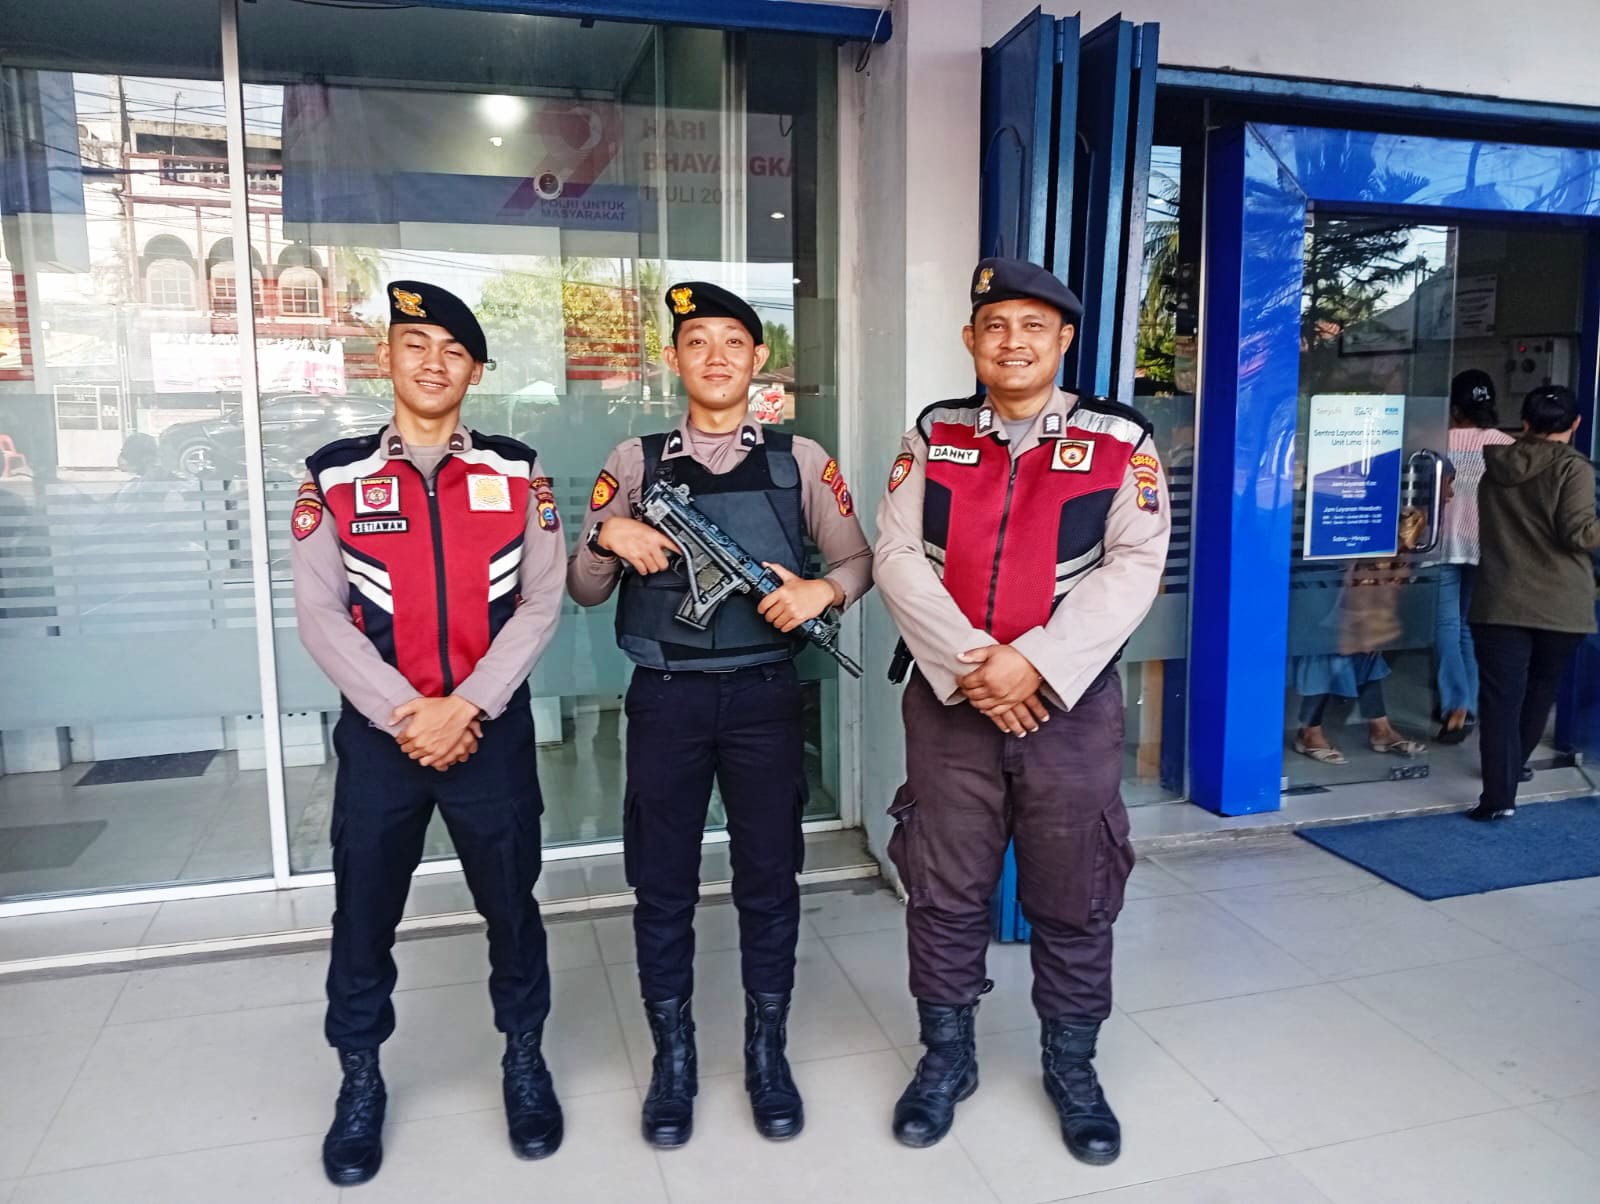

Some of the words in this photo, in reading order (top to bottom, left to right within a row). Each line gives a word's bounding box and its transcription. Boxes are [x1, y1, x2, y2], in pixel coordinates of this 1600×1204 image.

[641, 118, 706, 141] HARI
[582, 200, 625, 211] UNTUK
[541, 208, 625, 221] MASYARAKAT
[933, 447, 973, 460] DANNY
[355, 521, 403, 532] SETIAWAN
